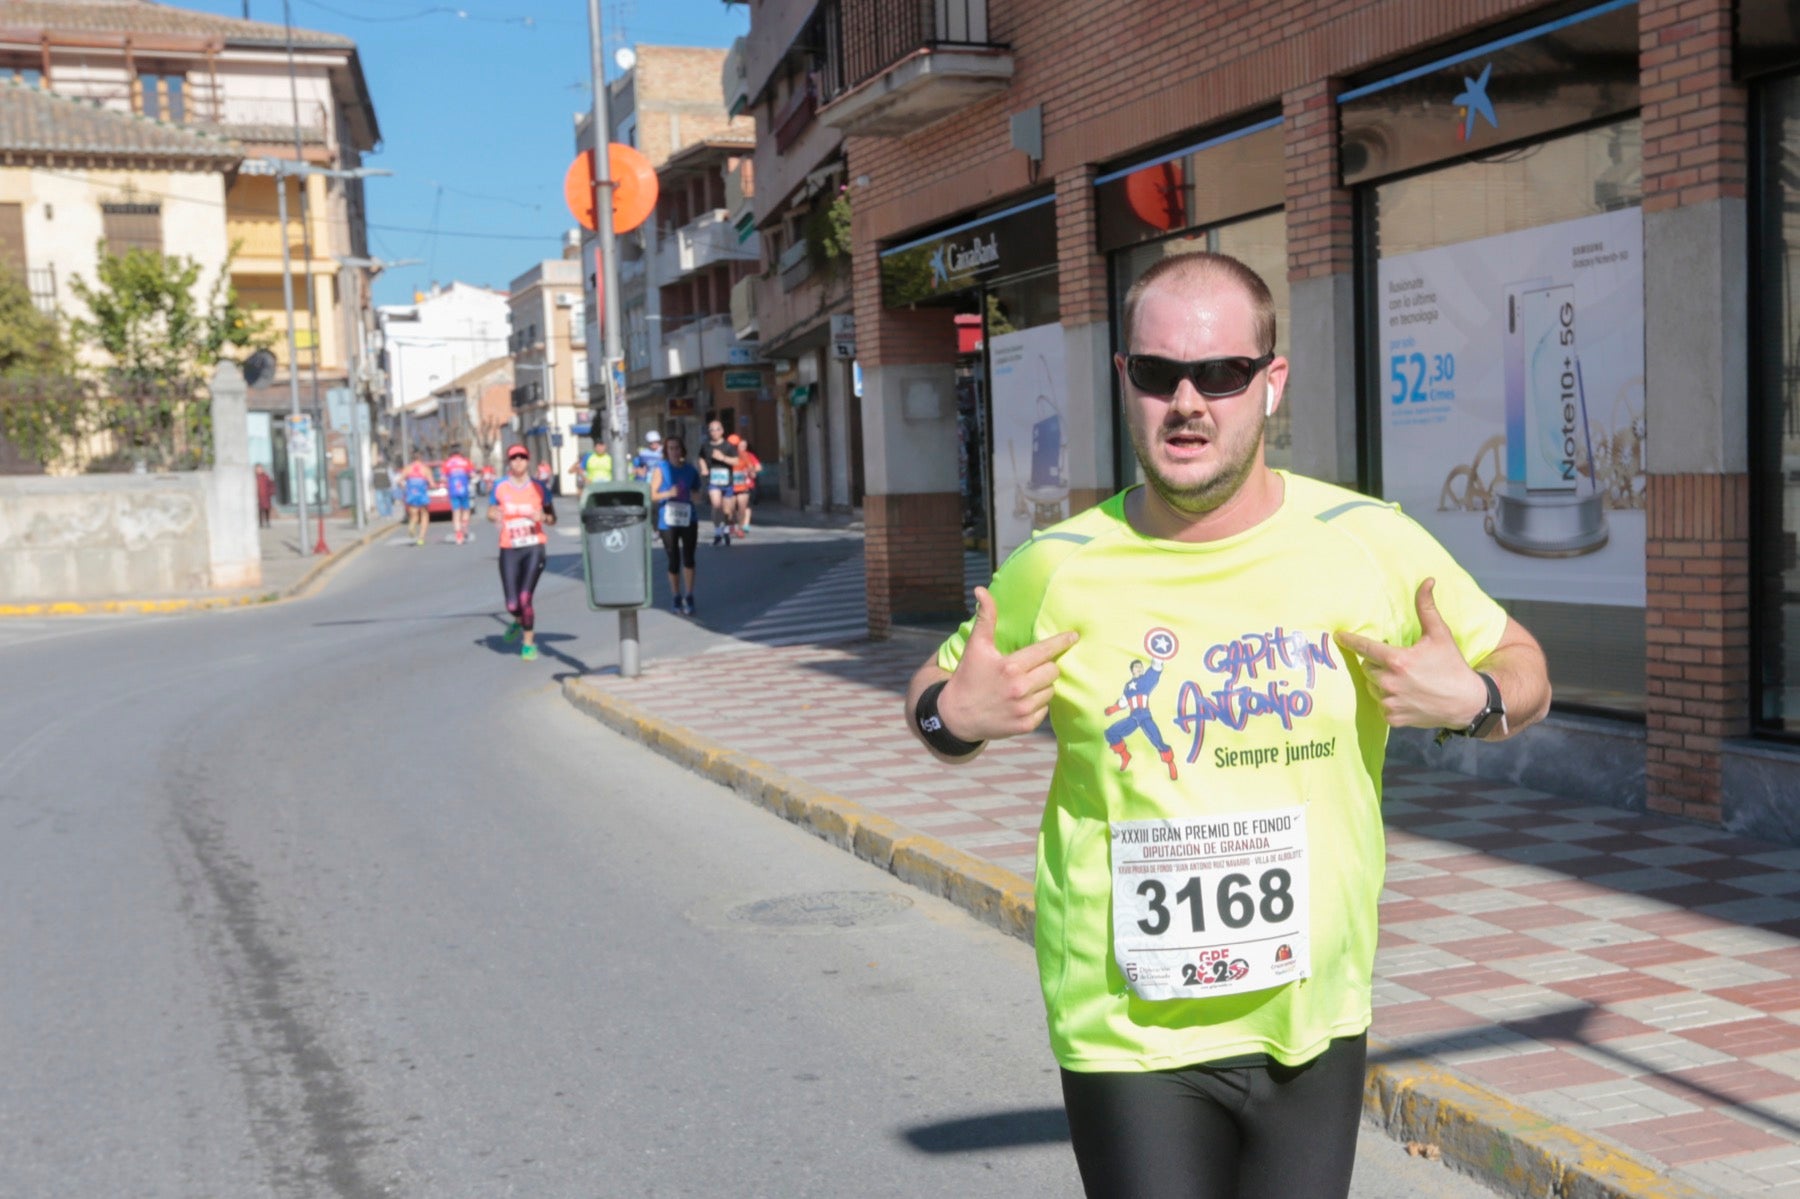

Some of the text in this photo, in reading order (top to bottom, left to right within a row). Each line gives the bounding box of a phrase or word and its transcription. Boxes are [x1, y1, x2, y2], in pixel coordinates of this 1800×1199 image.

[947, 232, 999, 272] CaixaBank
[1560, 302, 1576, 481] Note10+ 5G
[1214, 737, 1336, 768] Siempre juntos!
[1152, 827, 1182, 843] GRAN
[1185, 821, 1230, 840] PREMIO
[1233, 820, 1249, 837] DE
[1252, 815, 1292, 834] FONDO
[1203, 841, 1217, 855] DE
[1220, 836, 1270, 853] GRANADA
[1136, 868, 1294, 935] 3168
